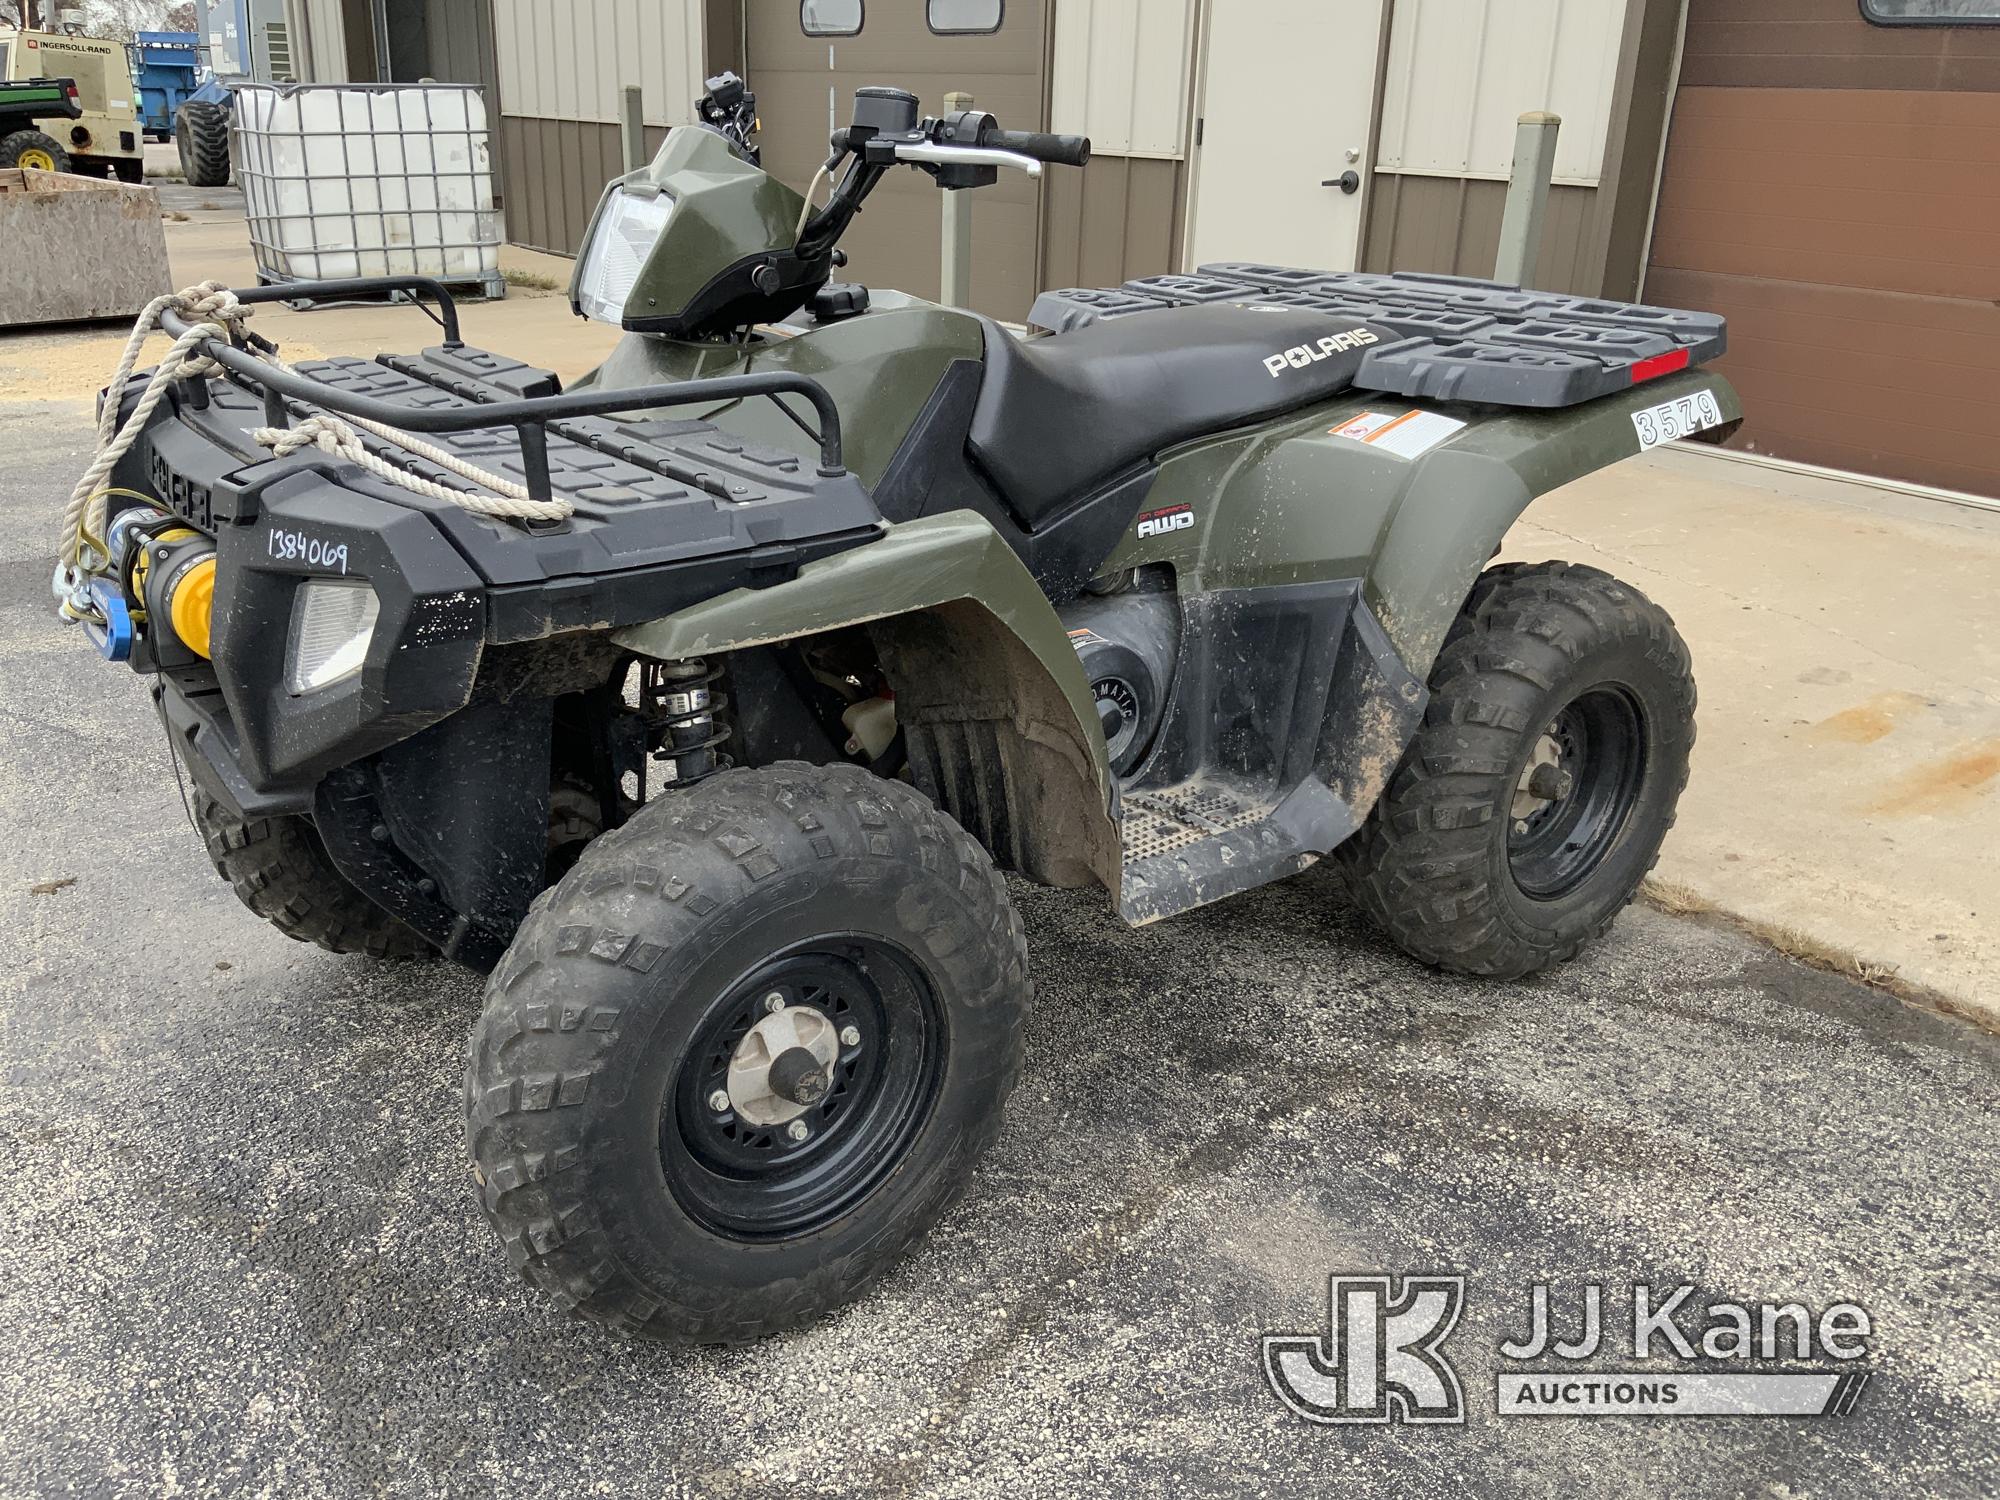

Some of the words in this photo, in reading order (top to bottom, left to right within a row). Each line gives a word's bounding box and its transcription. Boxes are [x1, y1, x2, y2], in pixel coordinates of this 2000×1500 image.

[40, 41, 112, 54] INGERSOLL-RAND
[1262, 327, 1379, 378] POLARIS
[1137, 511, 1195, 539] AWD
[268, 528, 348, 575] 1384069
